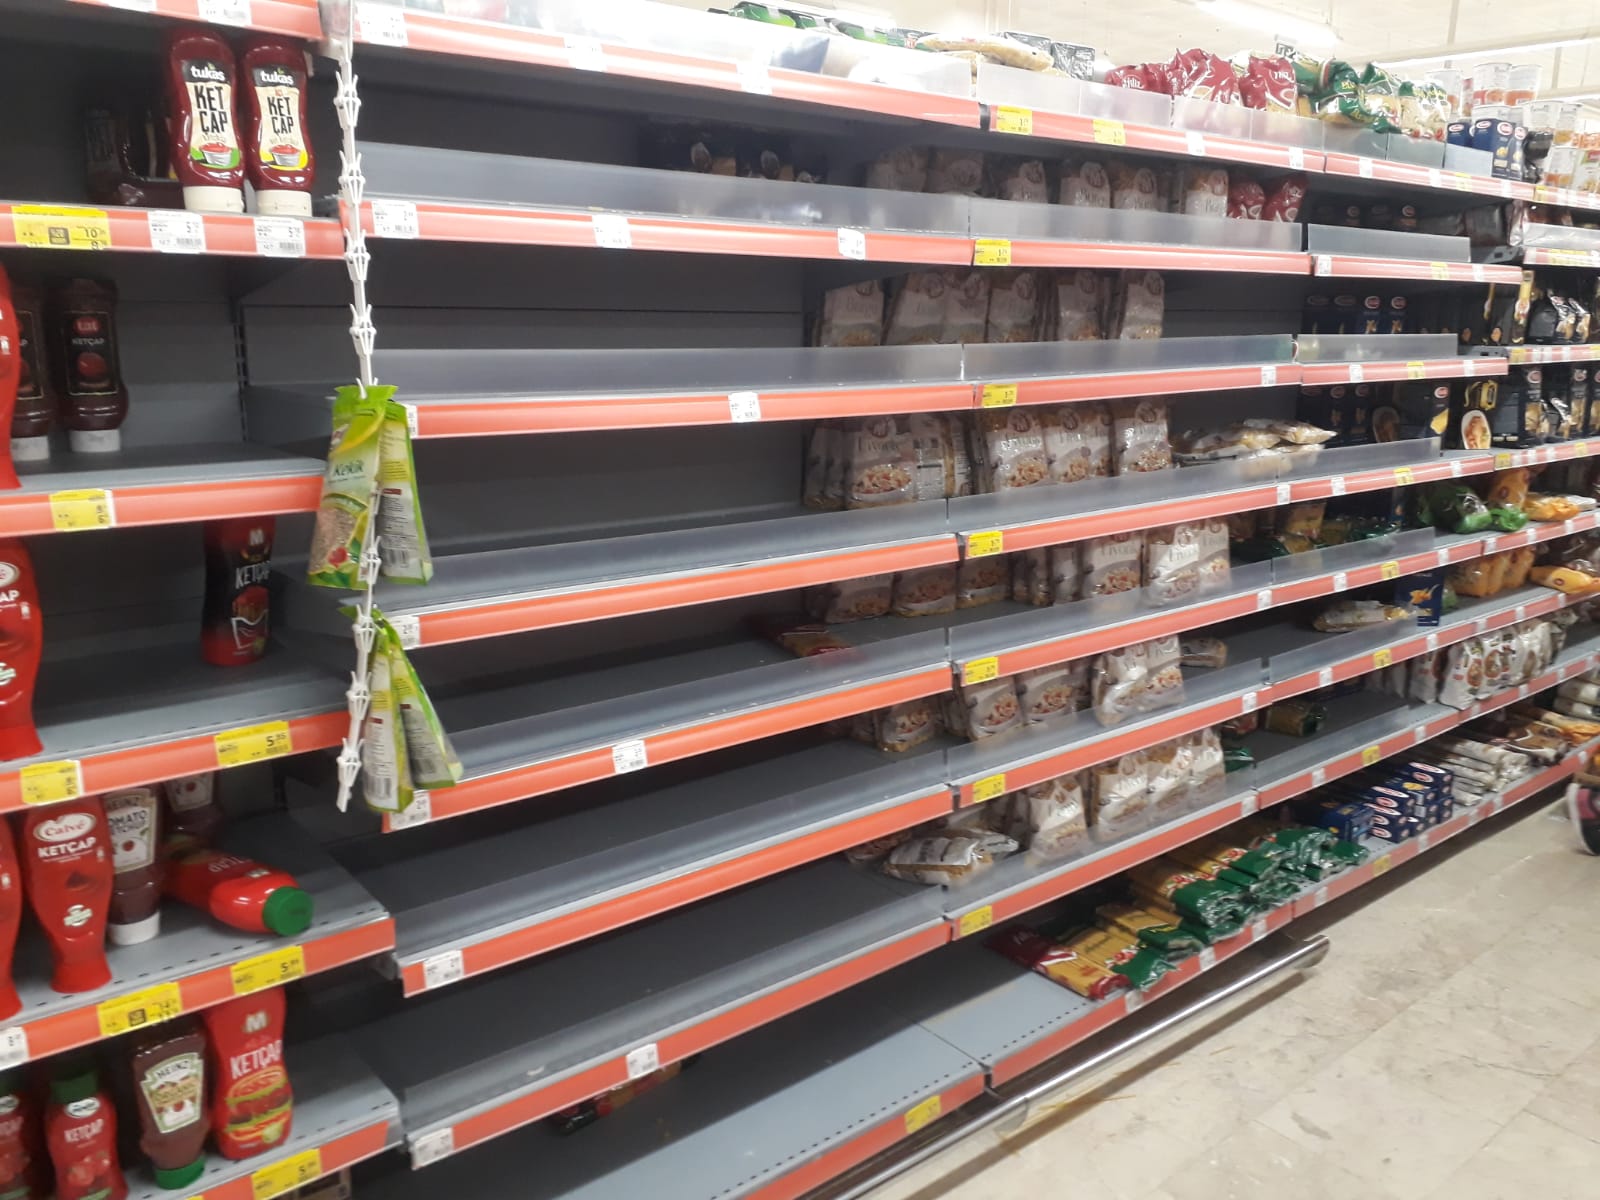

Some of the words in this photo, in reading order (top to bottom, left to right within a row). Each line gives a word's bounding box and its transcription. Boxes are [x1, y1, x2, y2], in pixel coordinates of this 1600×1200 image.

[194, 85, 224, 111] KET
[267, 96, 290, 117] KET
[108, 809, 148, 824] OMATO
